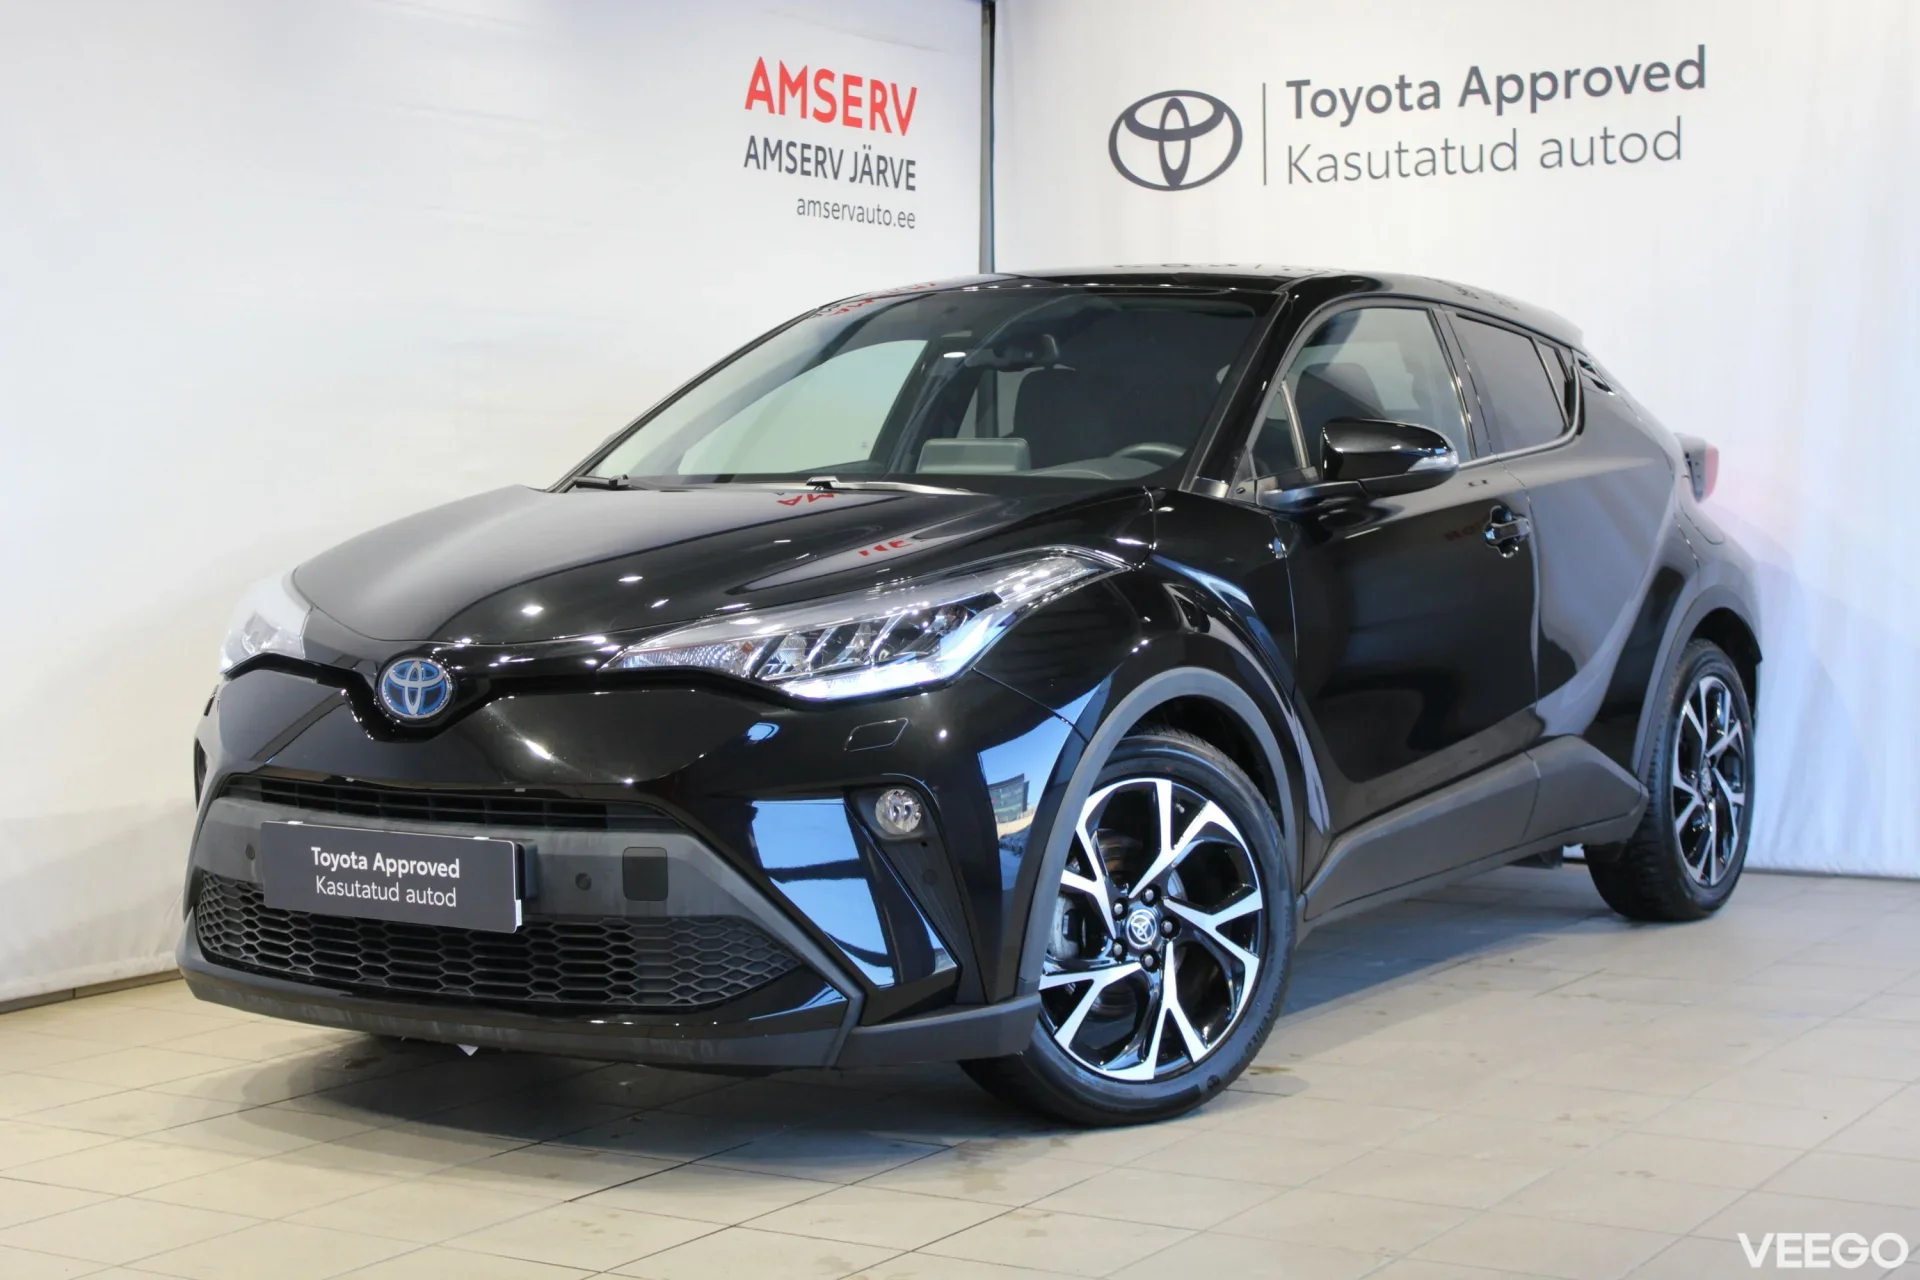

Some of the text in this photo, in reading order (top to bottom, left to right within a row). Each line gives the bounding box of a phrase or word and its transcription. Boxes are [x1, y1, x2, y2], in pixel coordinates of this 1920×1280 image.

[745, 56, 917, 136] AMSERV
[1286, 44, 1705, 127] Toyota Approved
[744, 135, 916, 191] AMSERV JÄRVE
[1288, 116, 1681, 184] Kasutatud autod
[796, 198, 916, 229] amservauto.ee
[311, 846, 460, 879] Toyota Approved
[316, 875, 457, 908] Kasutatud autod
